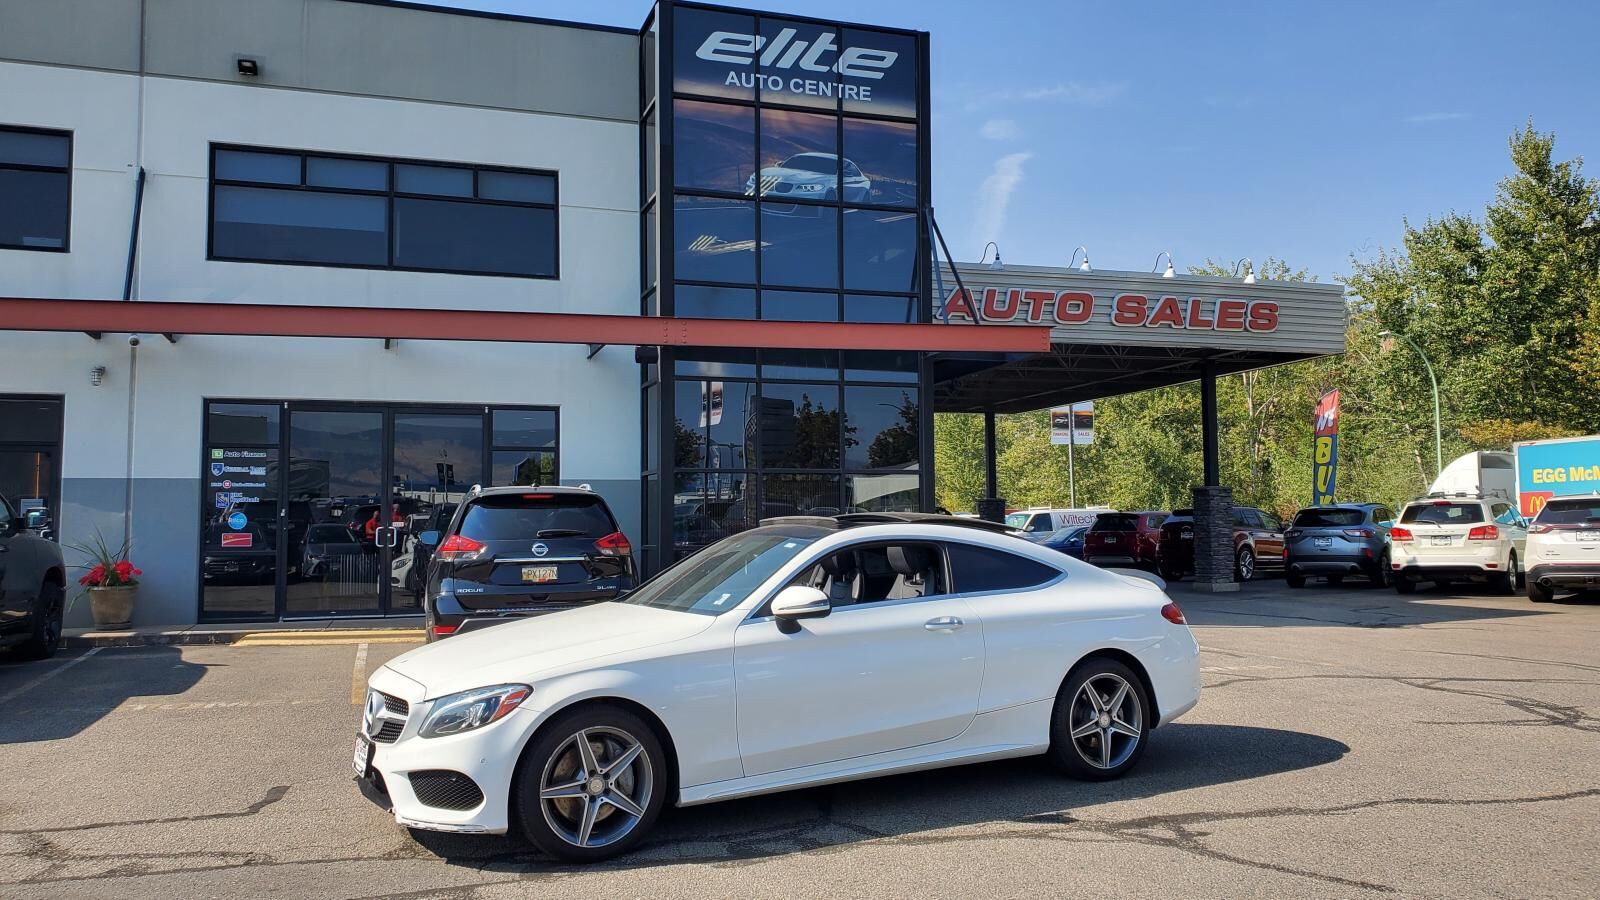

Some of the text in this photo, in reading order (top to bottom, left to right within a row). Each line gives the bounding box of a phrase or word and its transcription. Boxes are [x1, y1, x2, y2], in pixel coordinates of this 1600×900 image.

[695, 27, 899, 80] elite
[725, 71, 872, 102] AUTO CENTRE
[936, 285, 1280, 333] AUTO SALES
[1533, 467, 1566, 484] EGG
[1059, 514, 1097, 525] Wiltech
